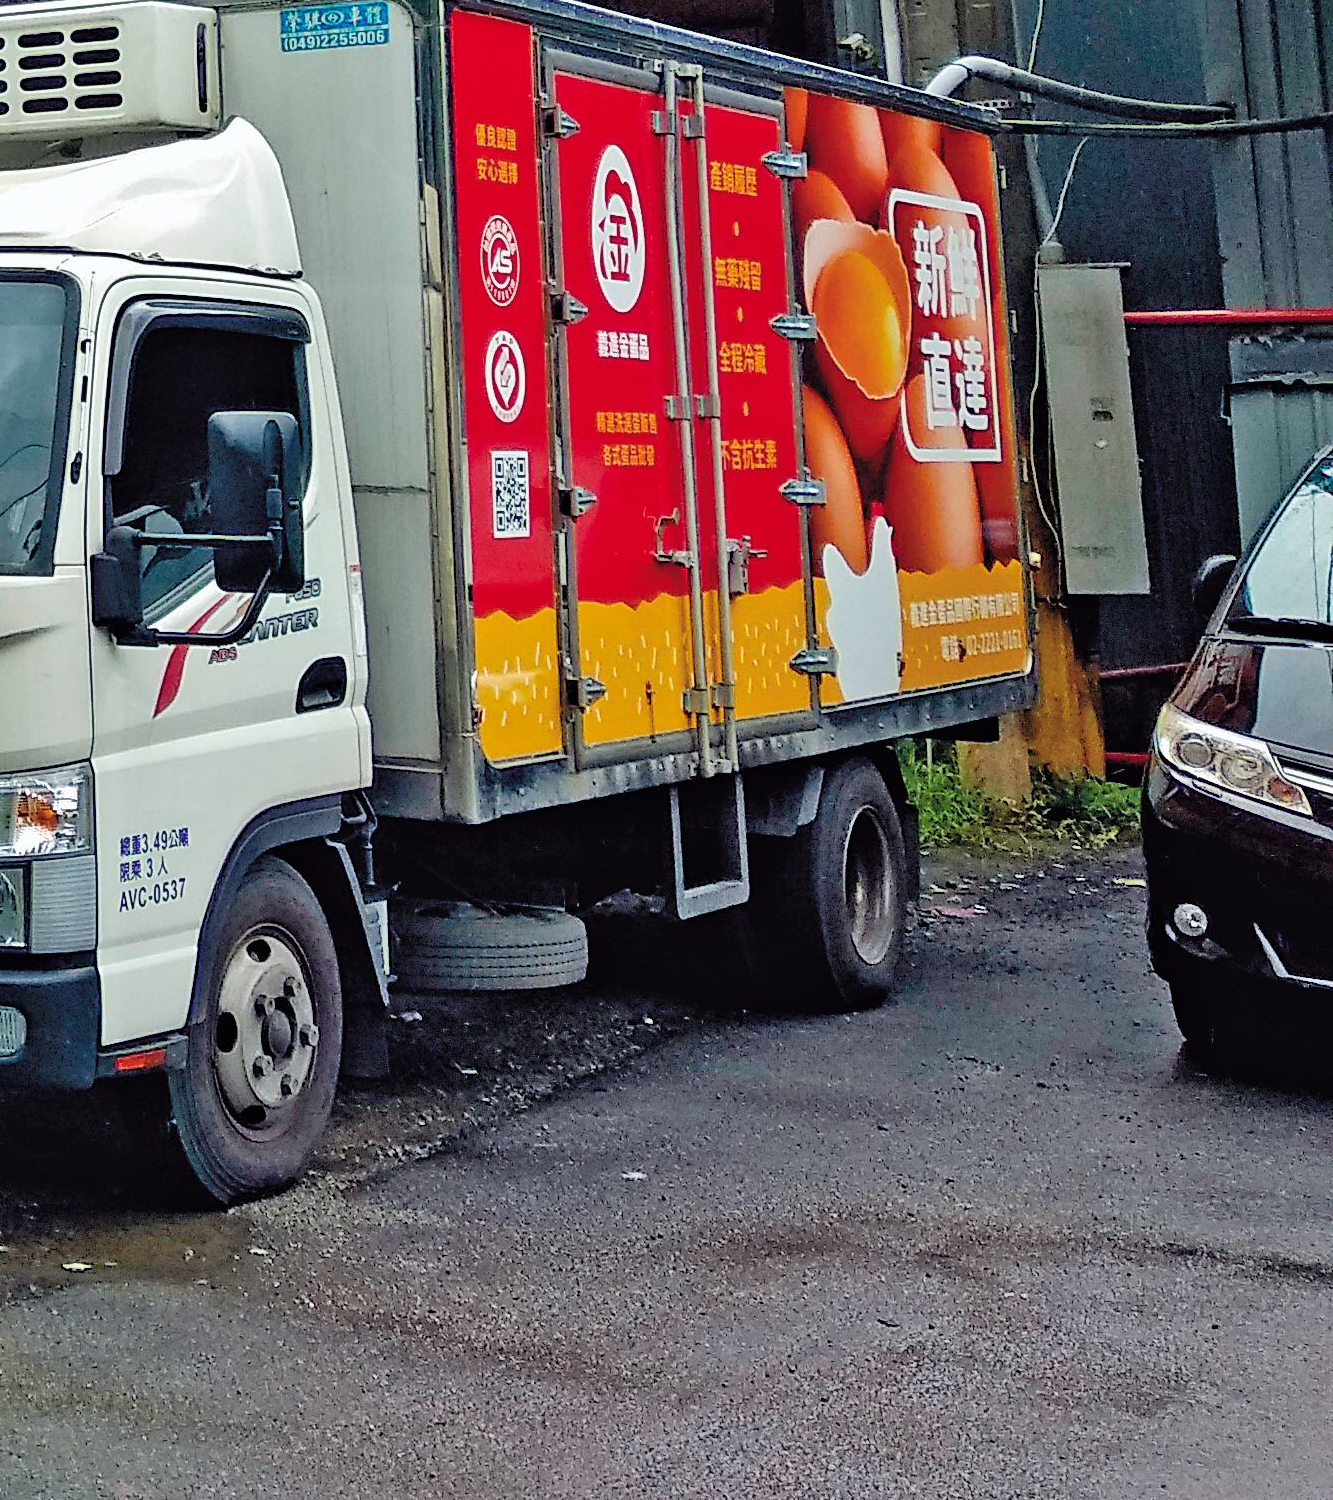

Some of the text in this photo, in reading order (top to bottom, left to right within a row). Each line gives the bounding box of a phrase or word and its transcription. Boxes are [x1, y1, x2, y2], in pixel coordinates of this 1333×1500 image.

[283, 30, 386, 51] (049)2255006
[912, 220, 981, 321] 新鮮
[718, 341, 767, 375] 全程冷藏
[920, 331, 989, 431] 直達
[145, 857, 154, 878] 3
[157, 855, 169, 877] 人
[118, 877, 186, 913] AVC-0537
